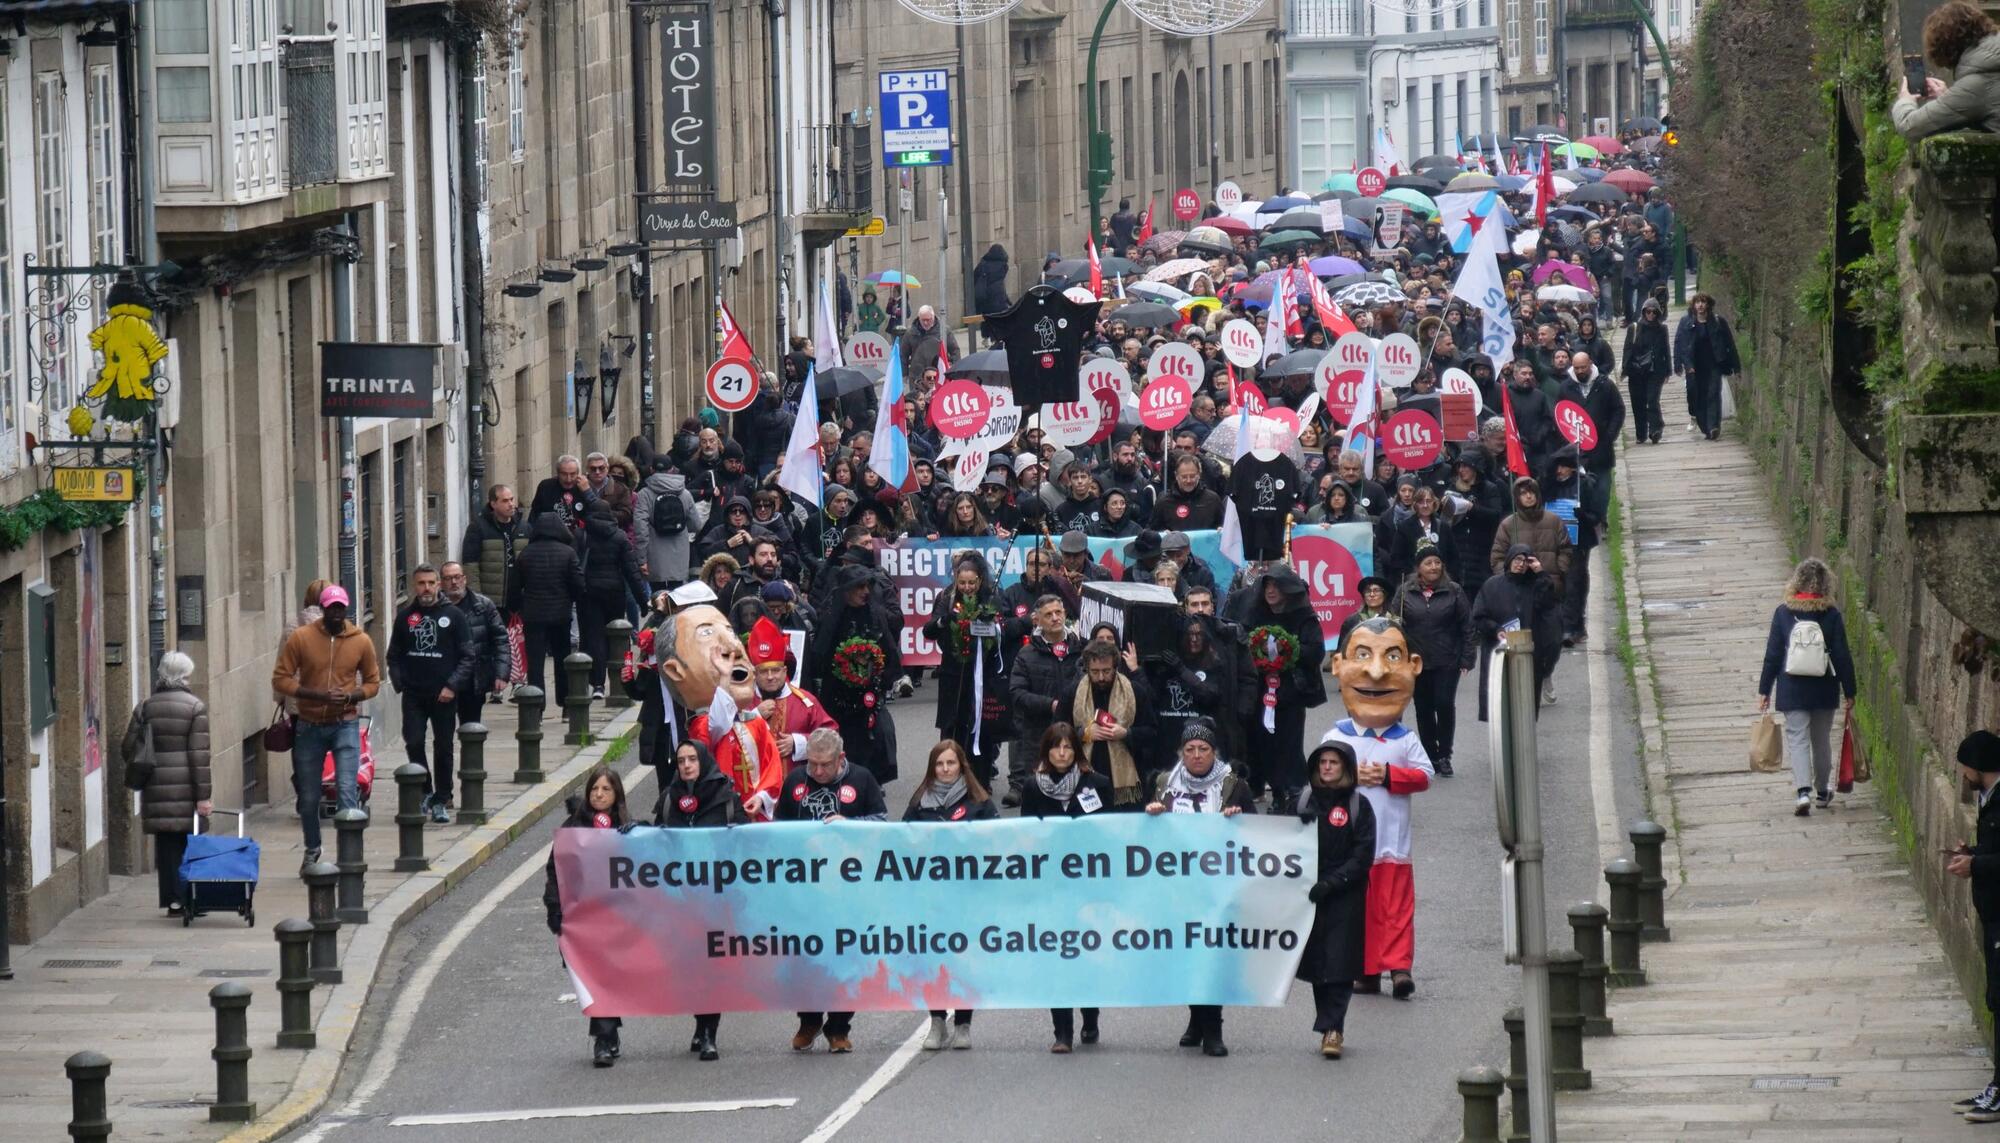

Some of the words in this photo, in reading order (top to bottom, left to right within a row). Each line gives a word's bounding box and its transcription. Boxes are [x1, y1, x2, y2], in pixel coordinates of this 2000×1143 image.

[888, 75, 900, 90] P
[925, 73, 937, 89] H
[666, 19, 703, 178] HOTEL
[899, 93, 927, 128] P
[1362, 174, 1381, 186] CIG
[1178, 195, 1196, 208] CIG
[1222, 188, 1237, 200] CIG
[646, 213, 680, 231] Virxe
[682, 213, 696, 228] da
[699, 210, 733, 229] Cerca
[1230, 328, 1255, 349] CIG
[854, 341, 883, 359] CIG
[1342, 344, 1369, 363] CIG
[1385, 345, 1412, 365] CIG
[1160, 355, 1193, 376] CIG
[326, 378, 415, 394] TRINTA
[720, 376, 743, 392] 21
[943, 391, 979, 416] CIG
[1150, 385, 1183, 409] CIG
[1394, 422, 1432, 445] CIG
[961, 451, 982, 476] CIG
[1404, 449, 1424, 458] ENSINO
[609, 856, 828, 894] Recuperar
[840, 857, 863, 883] e
[874, 850, 1049, 882] Avanzar
[1061, 852, 1111, 879] en
[1125, 841, 1304, 879] Dereitos
[707, 926, 824, 958] Ensino
[835, 923, 969, 956] Público
[979, 924, 1102, 960] Galego
[1112, 928, 1173, 951] con
[1185, 922, 1299, 951] Futuro
